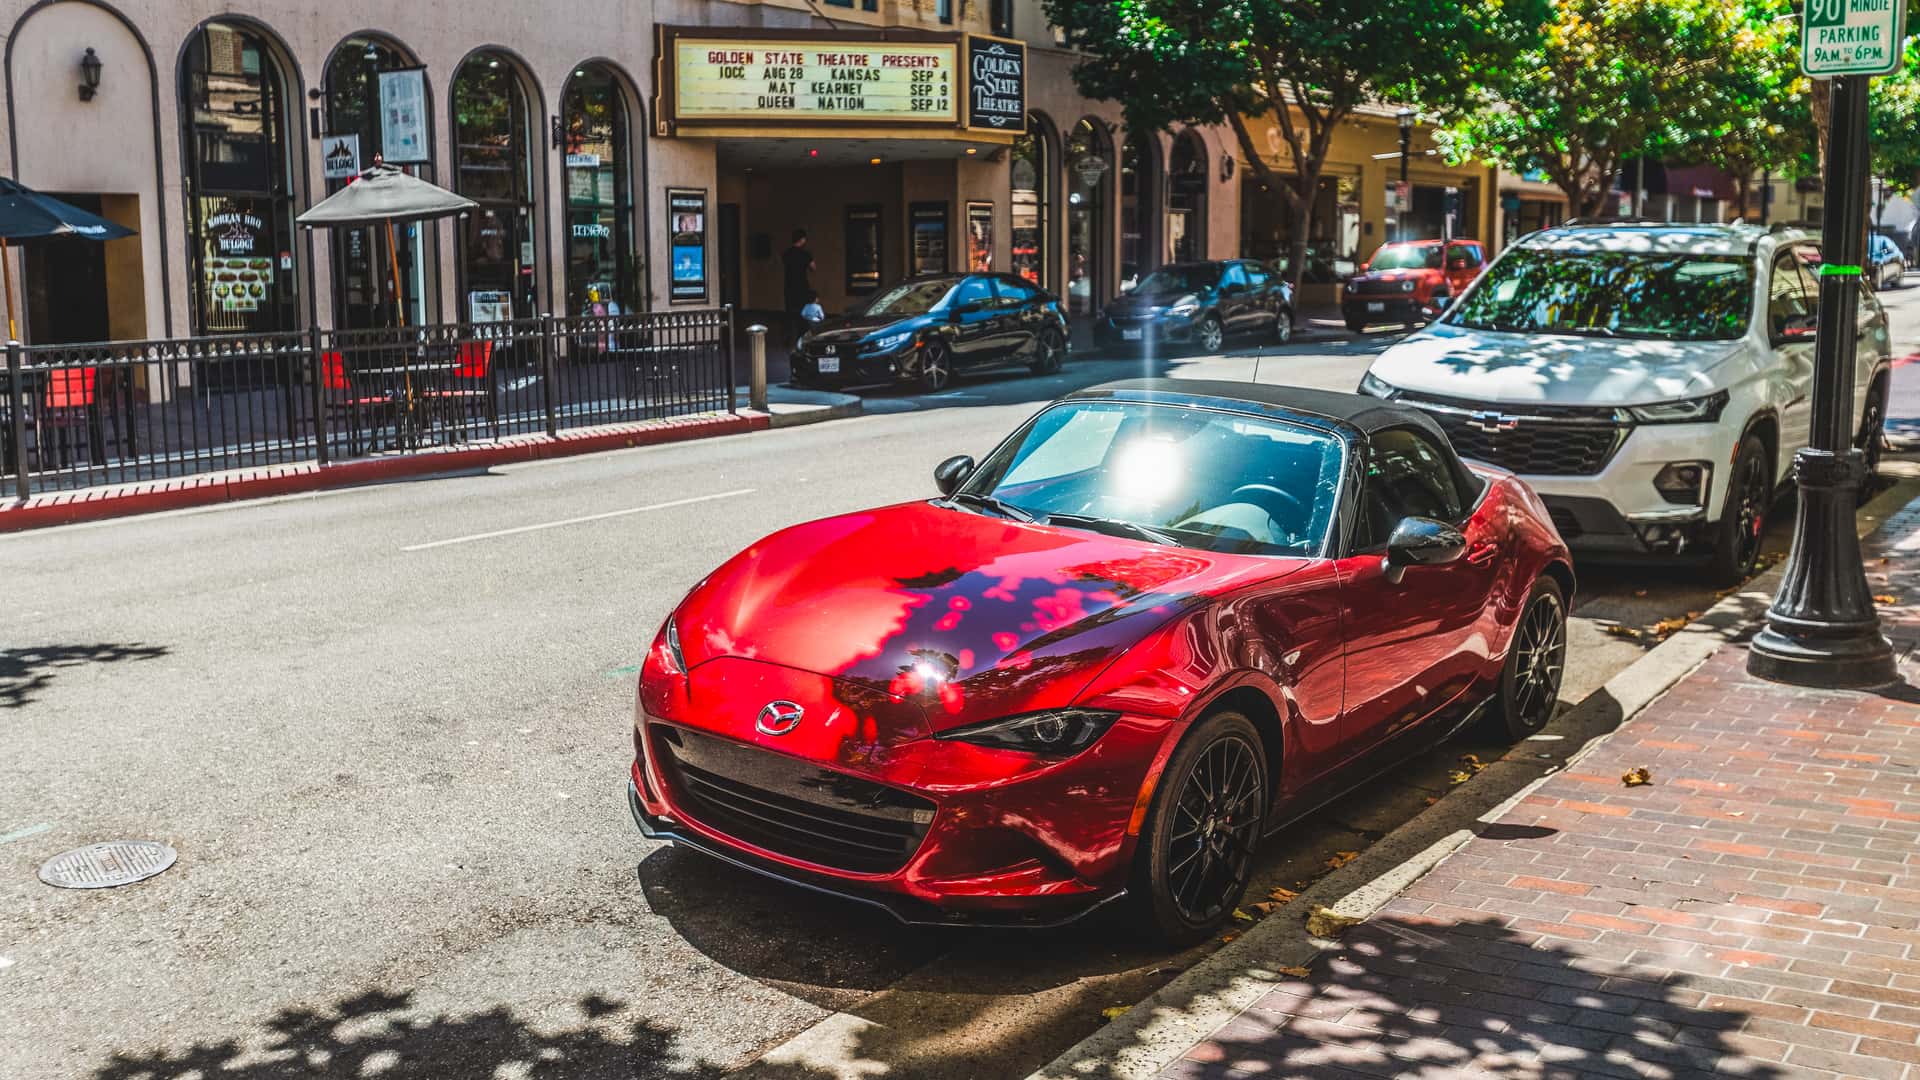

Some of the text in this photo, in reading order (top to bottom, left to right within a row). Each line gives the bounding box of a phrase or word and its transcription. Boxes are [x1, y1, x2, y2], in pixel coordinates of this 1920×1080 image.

[1812, 0, 1889, 21] 90 MINUTE
[1820, 26, 1880, 43] PARKING
[708, 51, 939, 67] GOLDEN STATE THEATRE PRESENTS
[763, 67, 786, 80] AUG
[790, 67, 803, 79] 28
[831, 68, 880, 81] KANSAS
[911, 70, 934, 82] SEP
[941, 71, 947, 82] 4
[768, 82, 948, 96] MAT KEARNEY SEP 9
[758, 96, 948, 111] QUEEN NATION SEP 12
